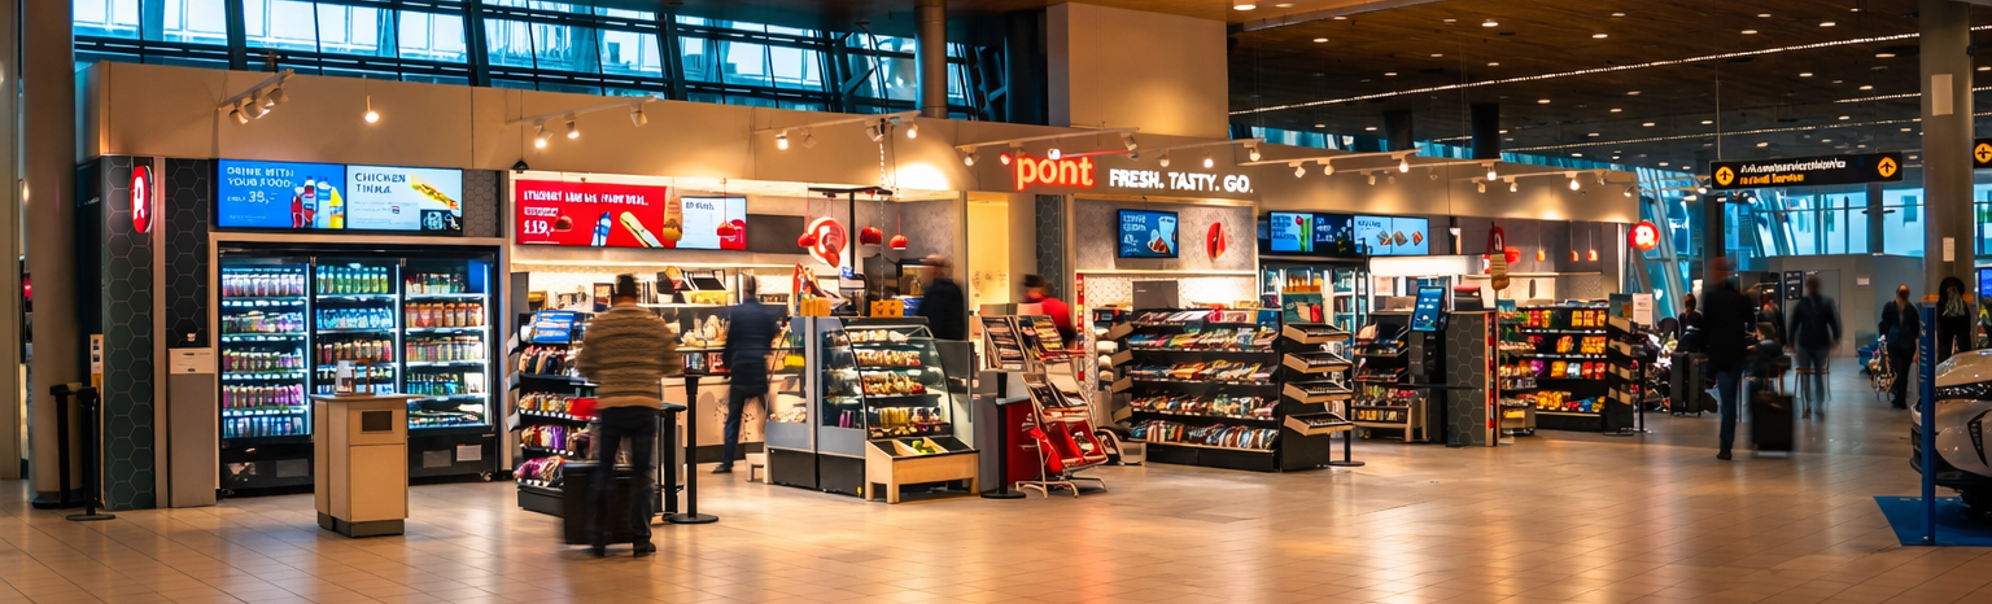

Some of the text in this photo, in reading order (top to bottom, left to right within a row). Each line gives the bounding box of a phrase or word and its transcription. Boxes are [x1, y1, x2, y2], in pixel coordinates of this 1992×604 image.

[1016, 156, 1094, 192] pont
[1109, 168, 1254, 193] FRESH. TASTY. GO.
